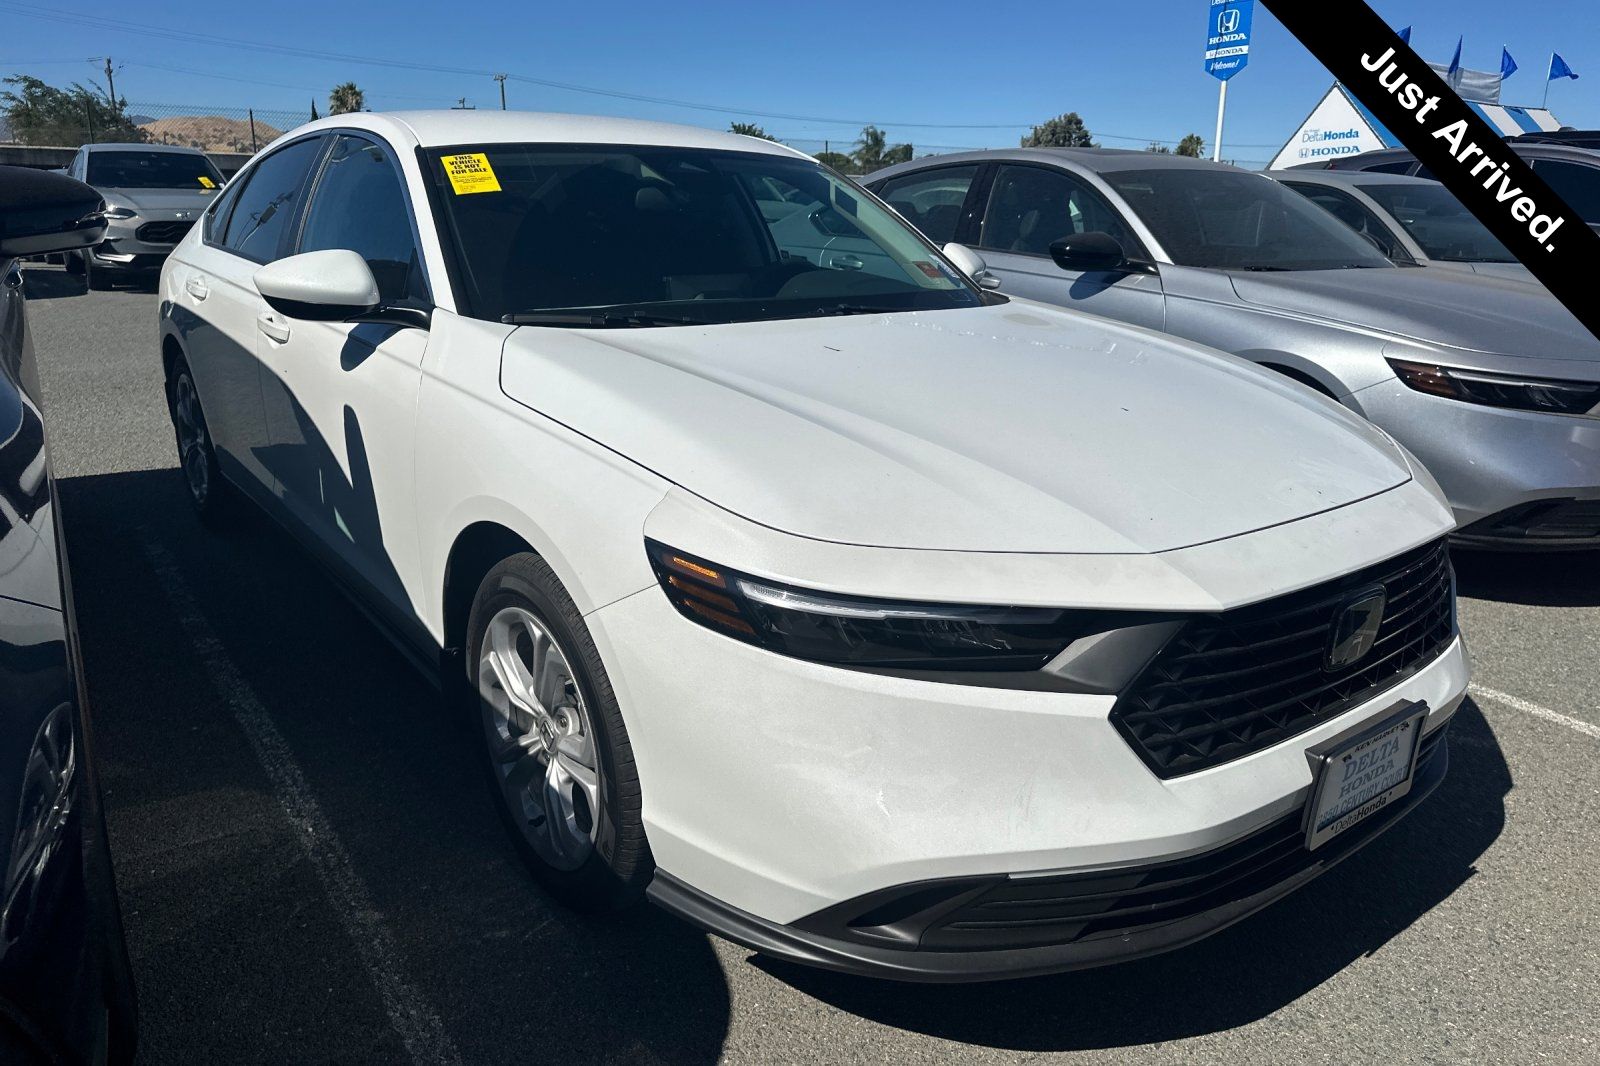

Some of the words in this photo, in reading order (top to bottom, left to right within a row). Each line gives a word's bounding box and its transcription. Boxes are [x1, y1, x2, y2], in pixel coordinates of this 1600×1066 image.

[1209, 33, 1247, 44] HONDA
[1311, 145, 1361, 156] HONDA
[1342, 736, 1400, 783] DELTA
[1339, 760, 1395, 799] HONDA
[1333, 795, 1387, 834] DeltaHonda
